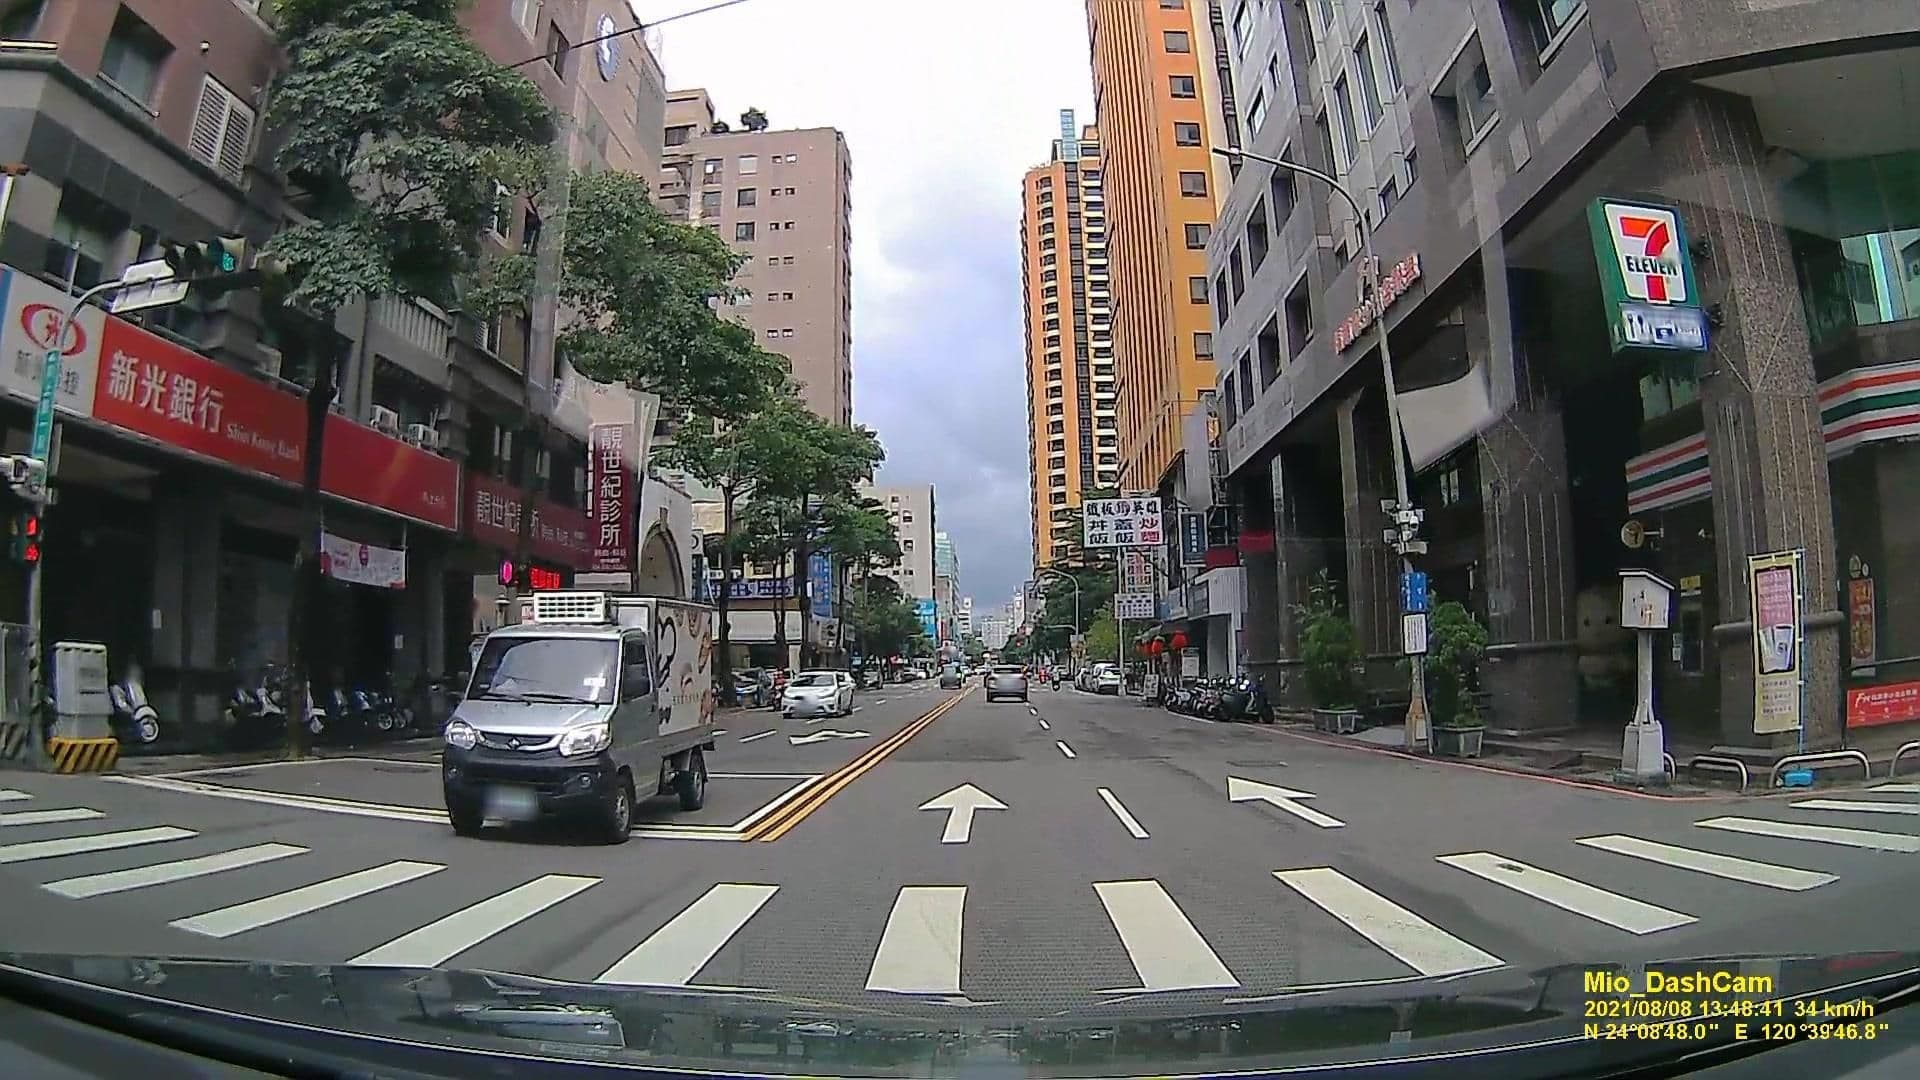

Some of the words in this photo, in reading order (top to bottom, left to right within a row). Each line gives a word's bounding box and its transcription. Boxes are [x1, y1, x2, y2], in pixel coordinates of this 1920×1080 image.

[109, 349, 224, 433] 新光銀行
[226, 423, 251, 445] Shin
[600, 426, 622, 547] 靚世紀診所
